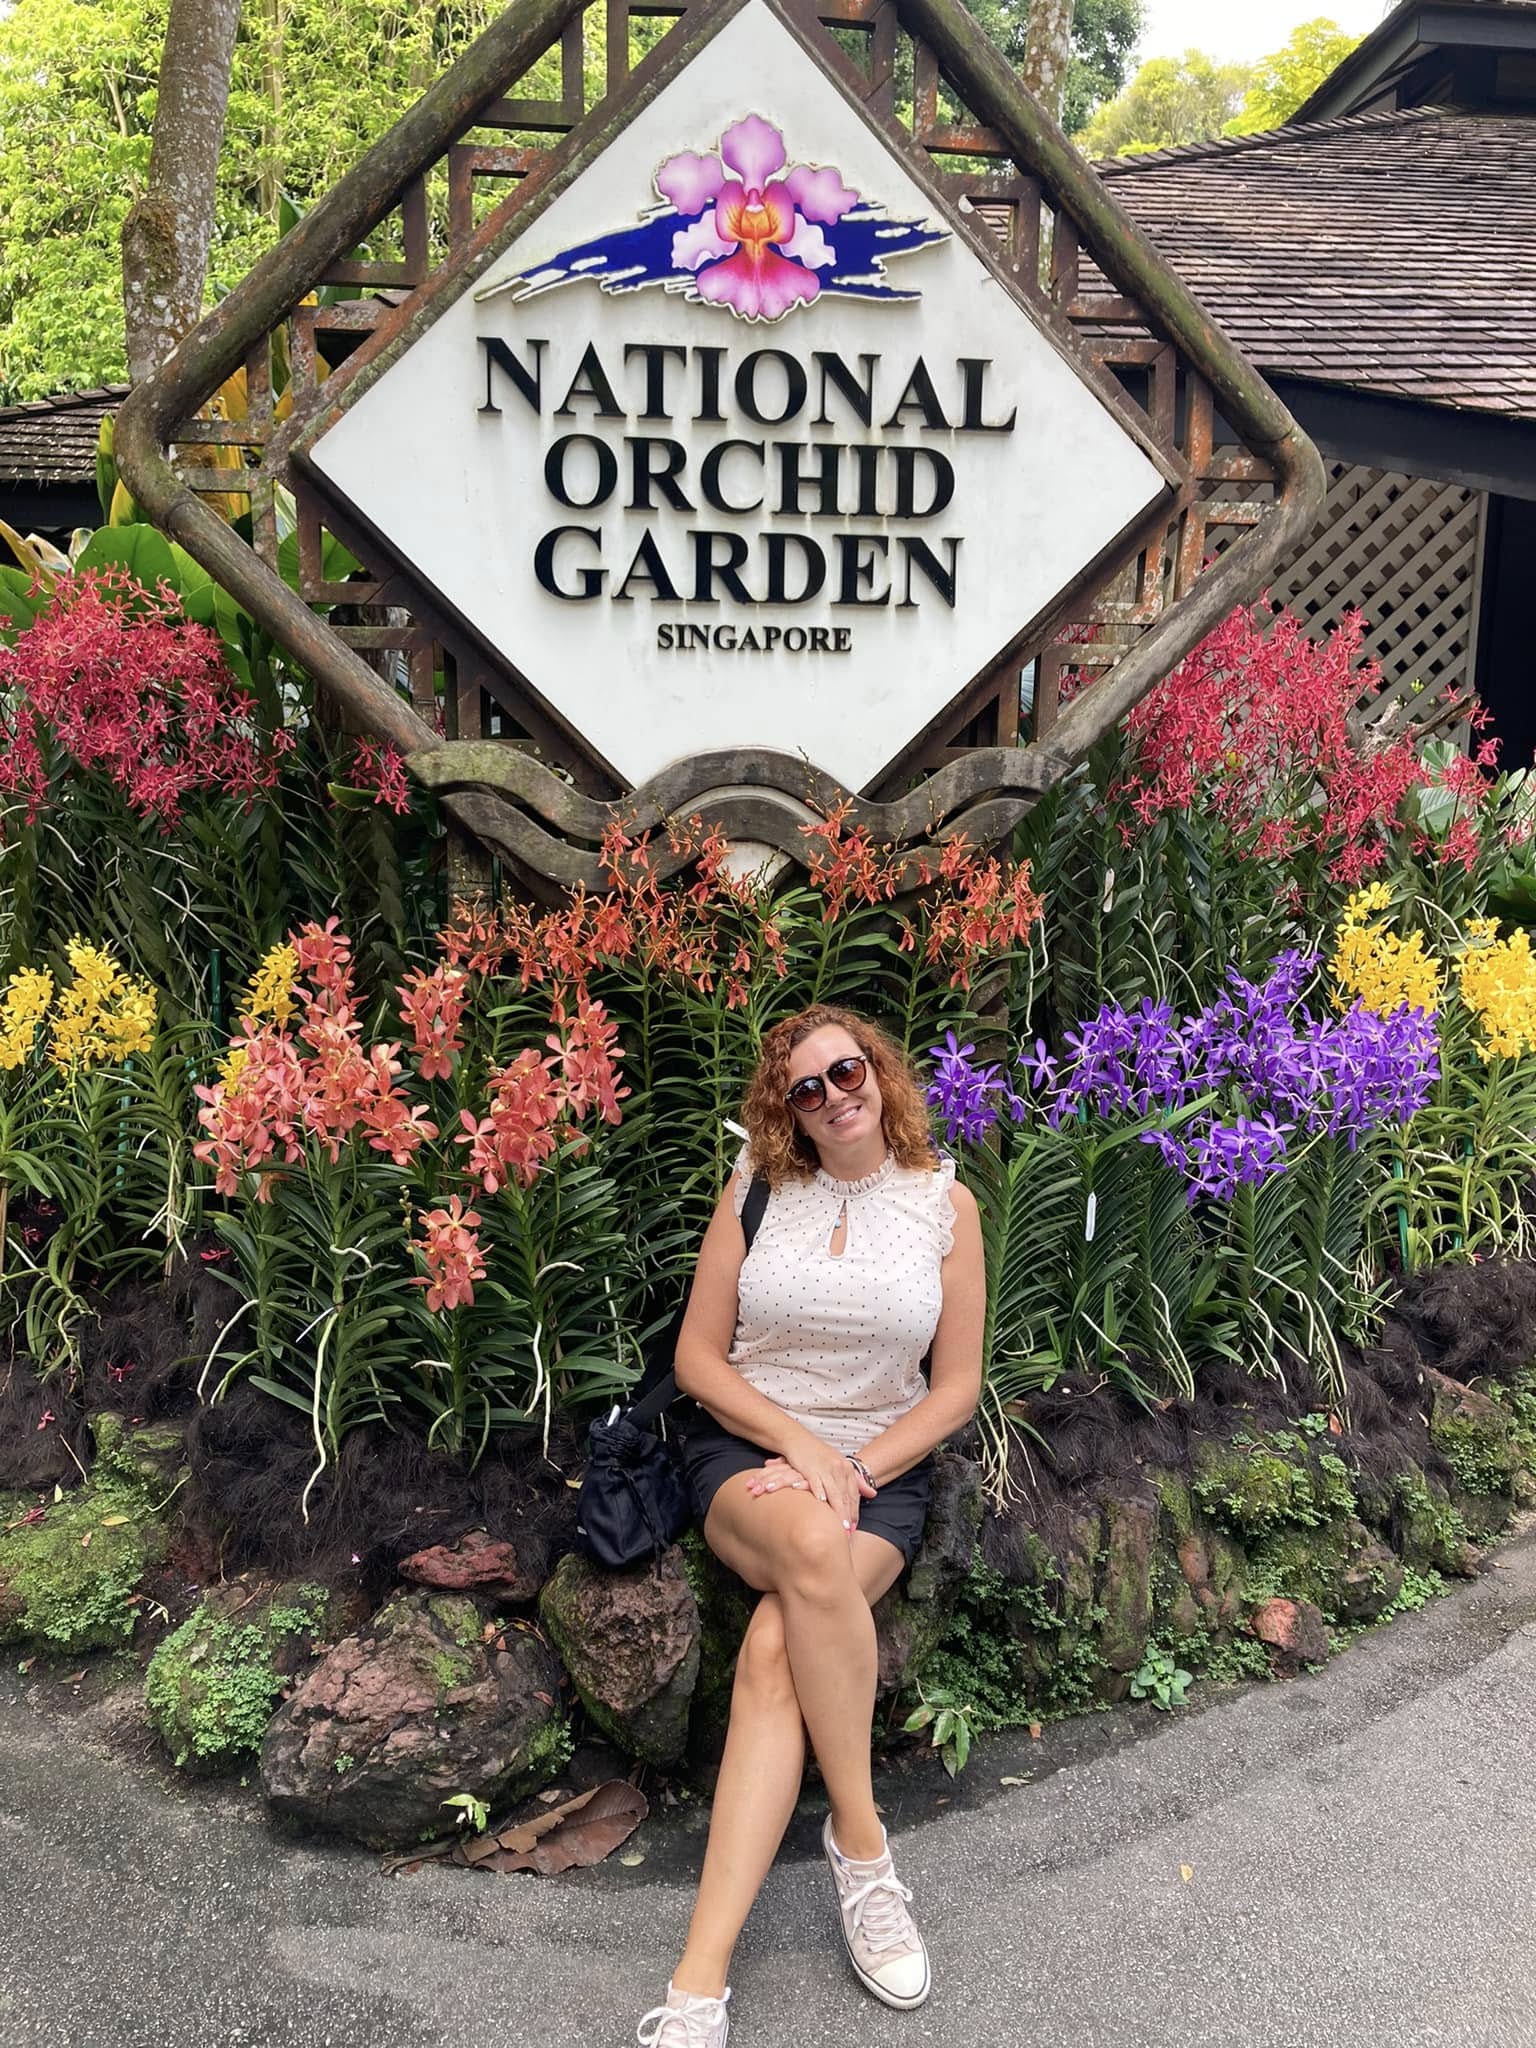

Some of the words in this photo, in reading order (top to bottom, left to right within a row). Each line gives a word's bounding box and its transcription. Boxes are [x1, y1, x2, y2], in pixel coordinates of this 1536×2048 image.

[477, 336, 1017, 432] NATIONAL
[544, 433, 955, 520] ORCHID
[534, 525, 964, 608] GARDEN
[657, 623, 852, 653] SINGAPORE
